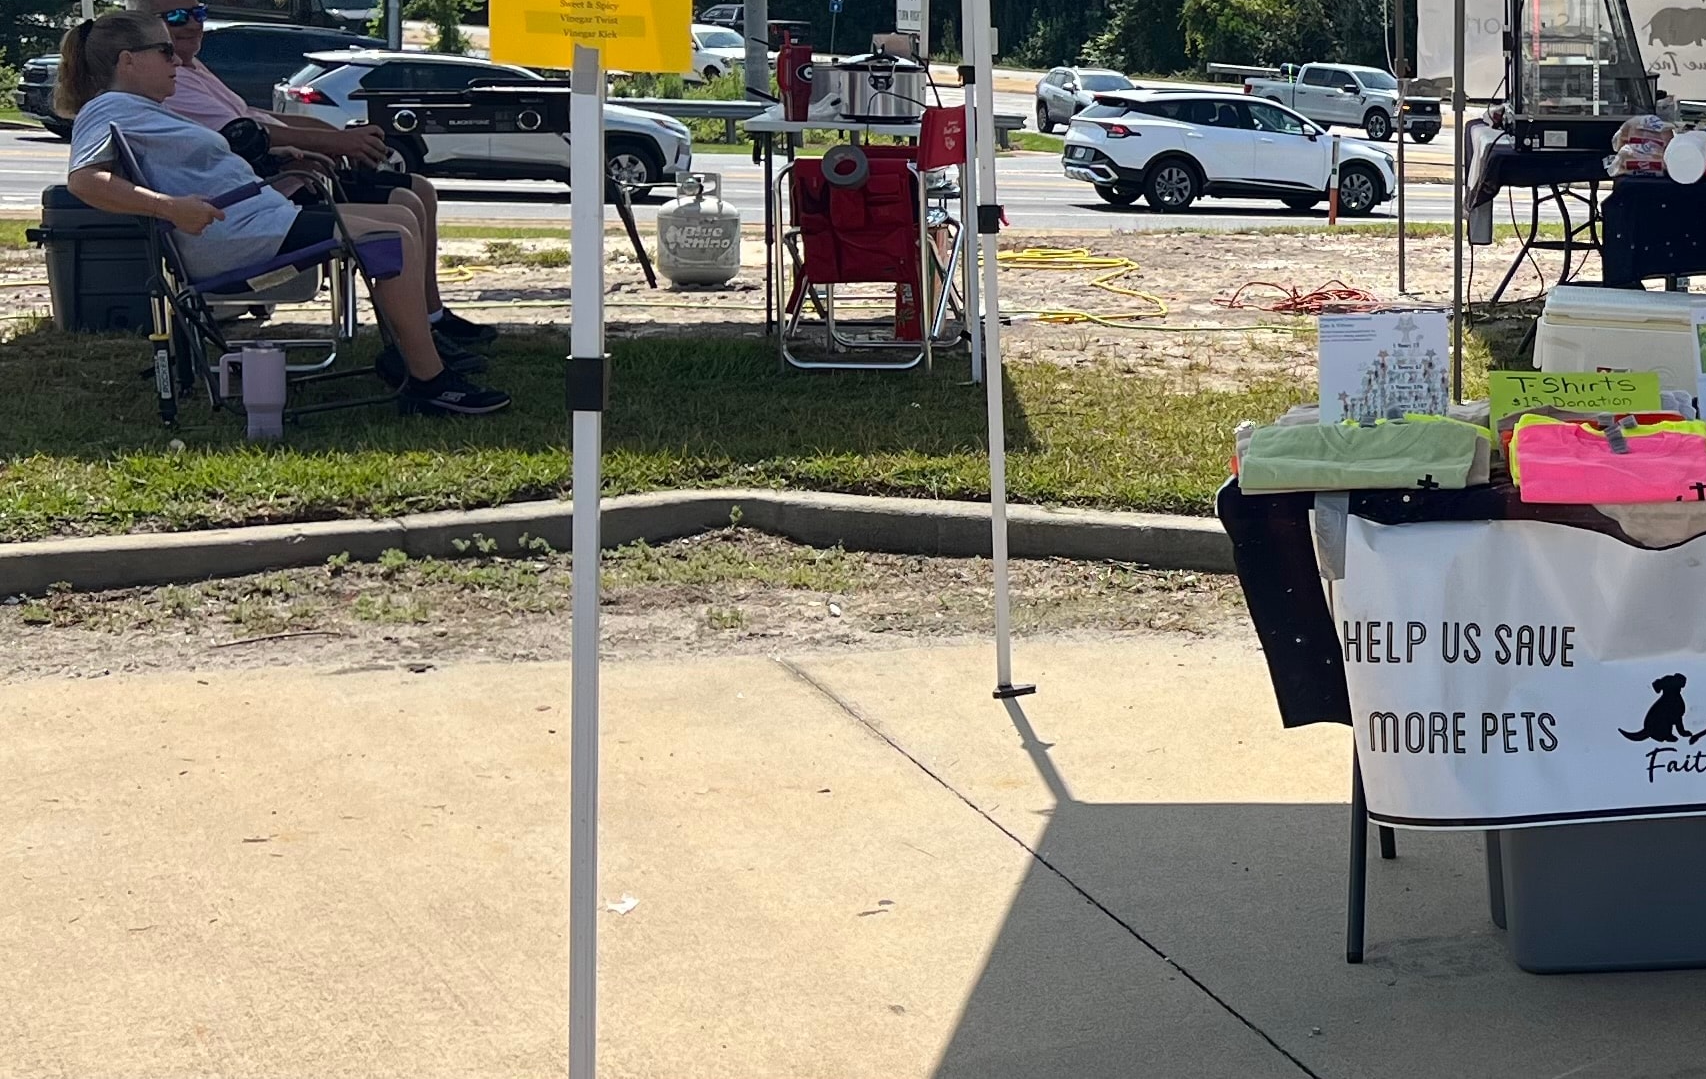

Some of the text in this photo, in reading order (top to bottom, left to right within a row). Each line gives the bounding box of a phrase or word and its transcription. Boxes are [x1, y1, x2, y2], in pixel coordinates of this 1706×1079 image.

[560, 0, 584, 9] Sweet
[595, 1, 619, 11] Spicy
[560, 13, 618, 25] Vinegar Twist
[563, 29, 618, 39] Vinegar Kick
[1506, 375, 1636, 395] T-Shirts
[1553, 397, 1632, 408] Donation
[1343, 621, 1576, 667] HELP US SAVE
[1369, 712, 1558, 754] MORE PETS
